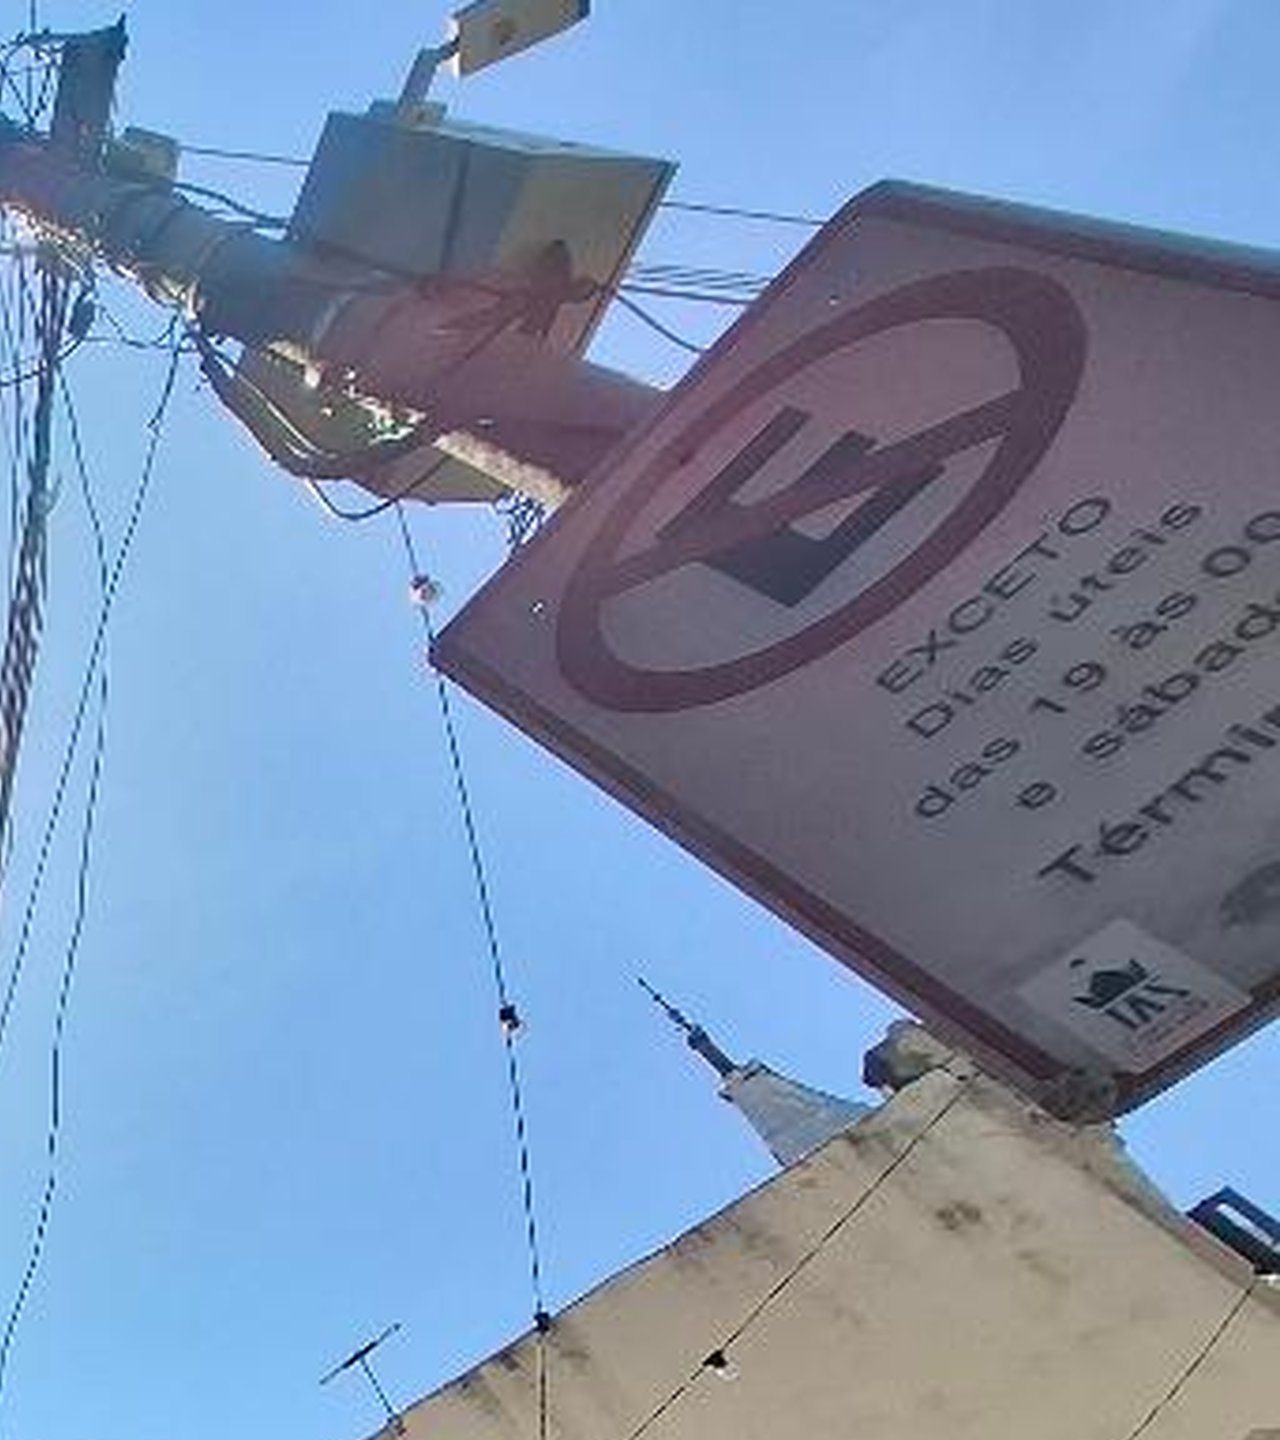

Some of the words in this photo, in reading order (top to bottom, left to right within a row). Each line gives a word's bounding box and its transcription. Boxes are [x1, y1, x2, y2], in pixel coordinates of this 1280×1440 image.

[877, 497, 1110, 694] EXCETO
[905, 636, 1038, 739] Dias
[1017, 781, 1058, 810] e
[1082, 594, 1280, 760] sábad
[915, 737, 1021, 818] das
